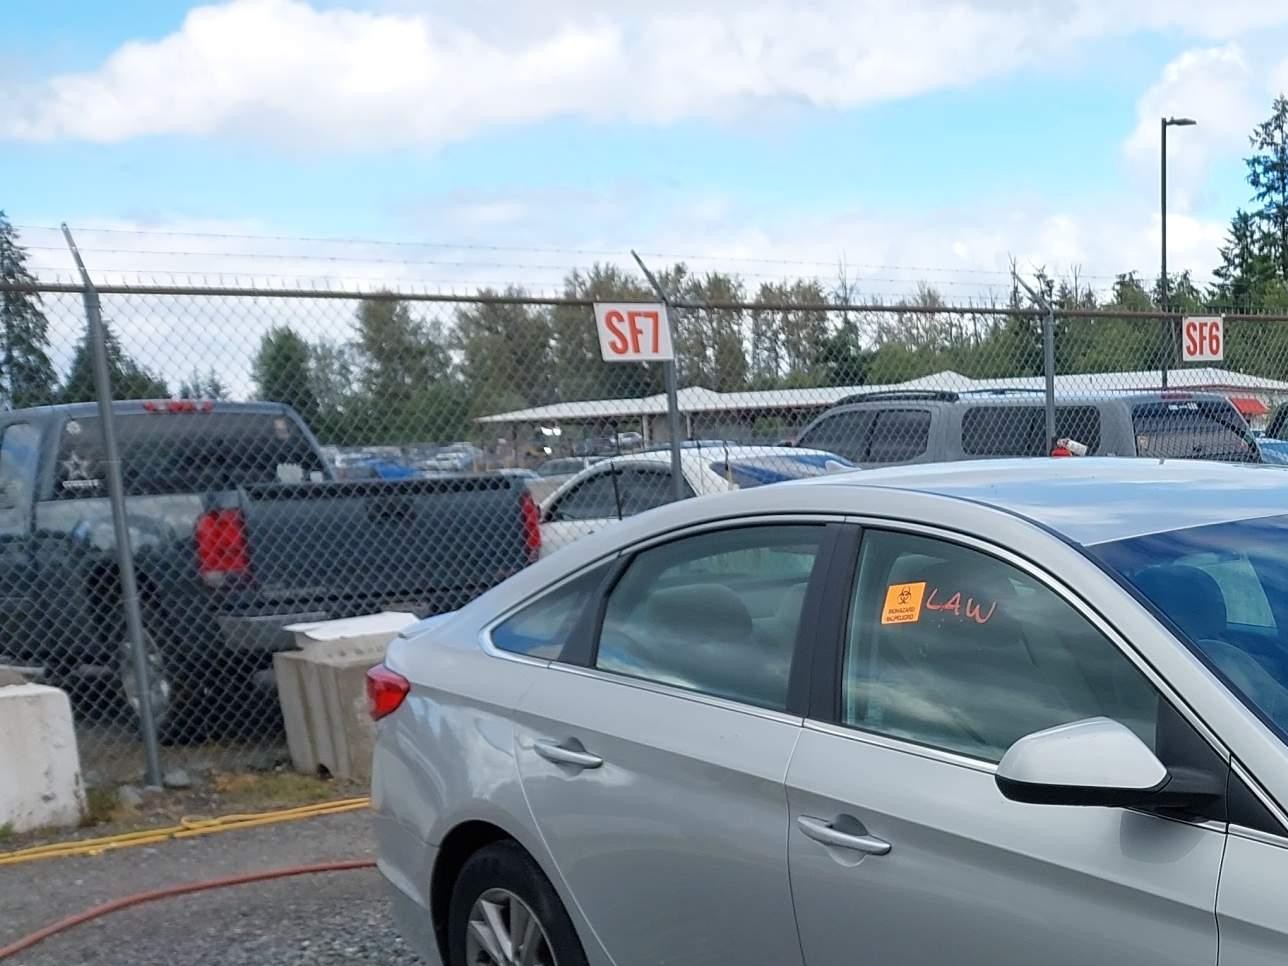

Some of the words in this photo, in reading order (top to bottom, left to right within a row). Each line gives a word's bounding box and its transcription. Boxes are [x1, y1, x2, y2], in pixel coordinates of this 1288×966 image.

[605, 311, 659, 354] SF7
[1186, 321, 1220, 356] SF6
[926, 587, 997, 624] LAW
